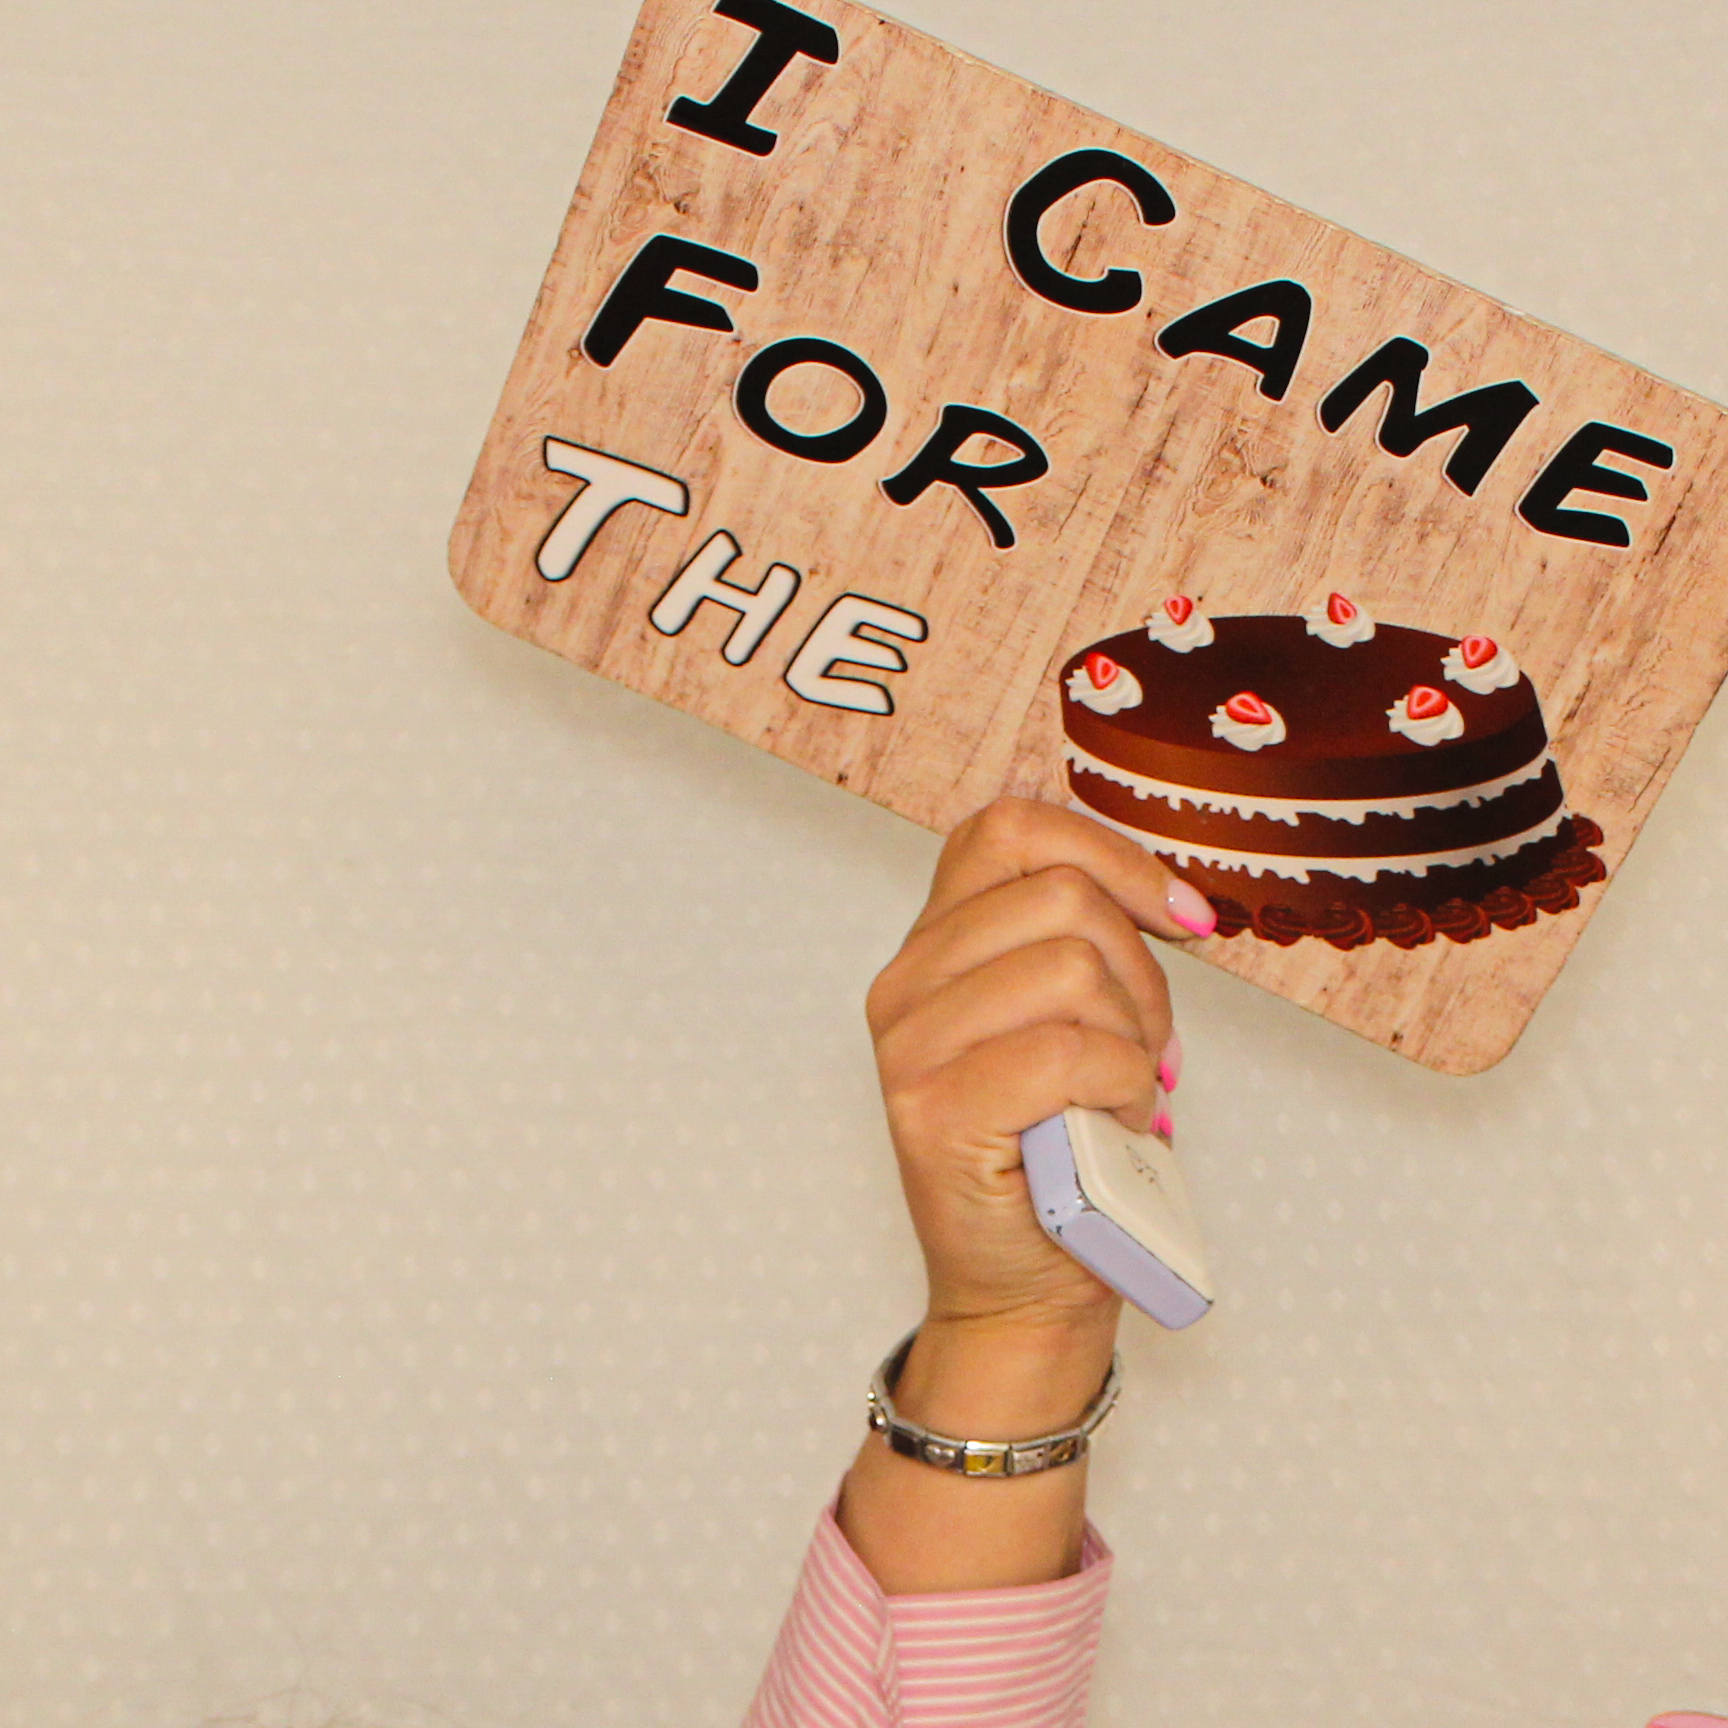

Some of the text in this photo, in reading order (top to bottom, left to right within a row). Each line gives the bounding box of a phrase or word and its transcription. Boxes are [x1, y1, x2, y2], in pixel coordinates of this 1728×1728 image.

[581, 233, 1050, 551] FOR
[664, 0, 1676, 548] I CAME
[534, 435, 929, 718] THE
